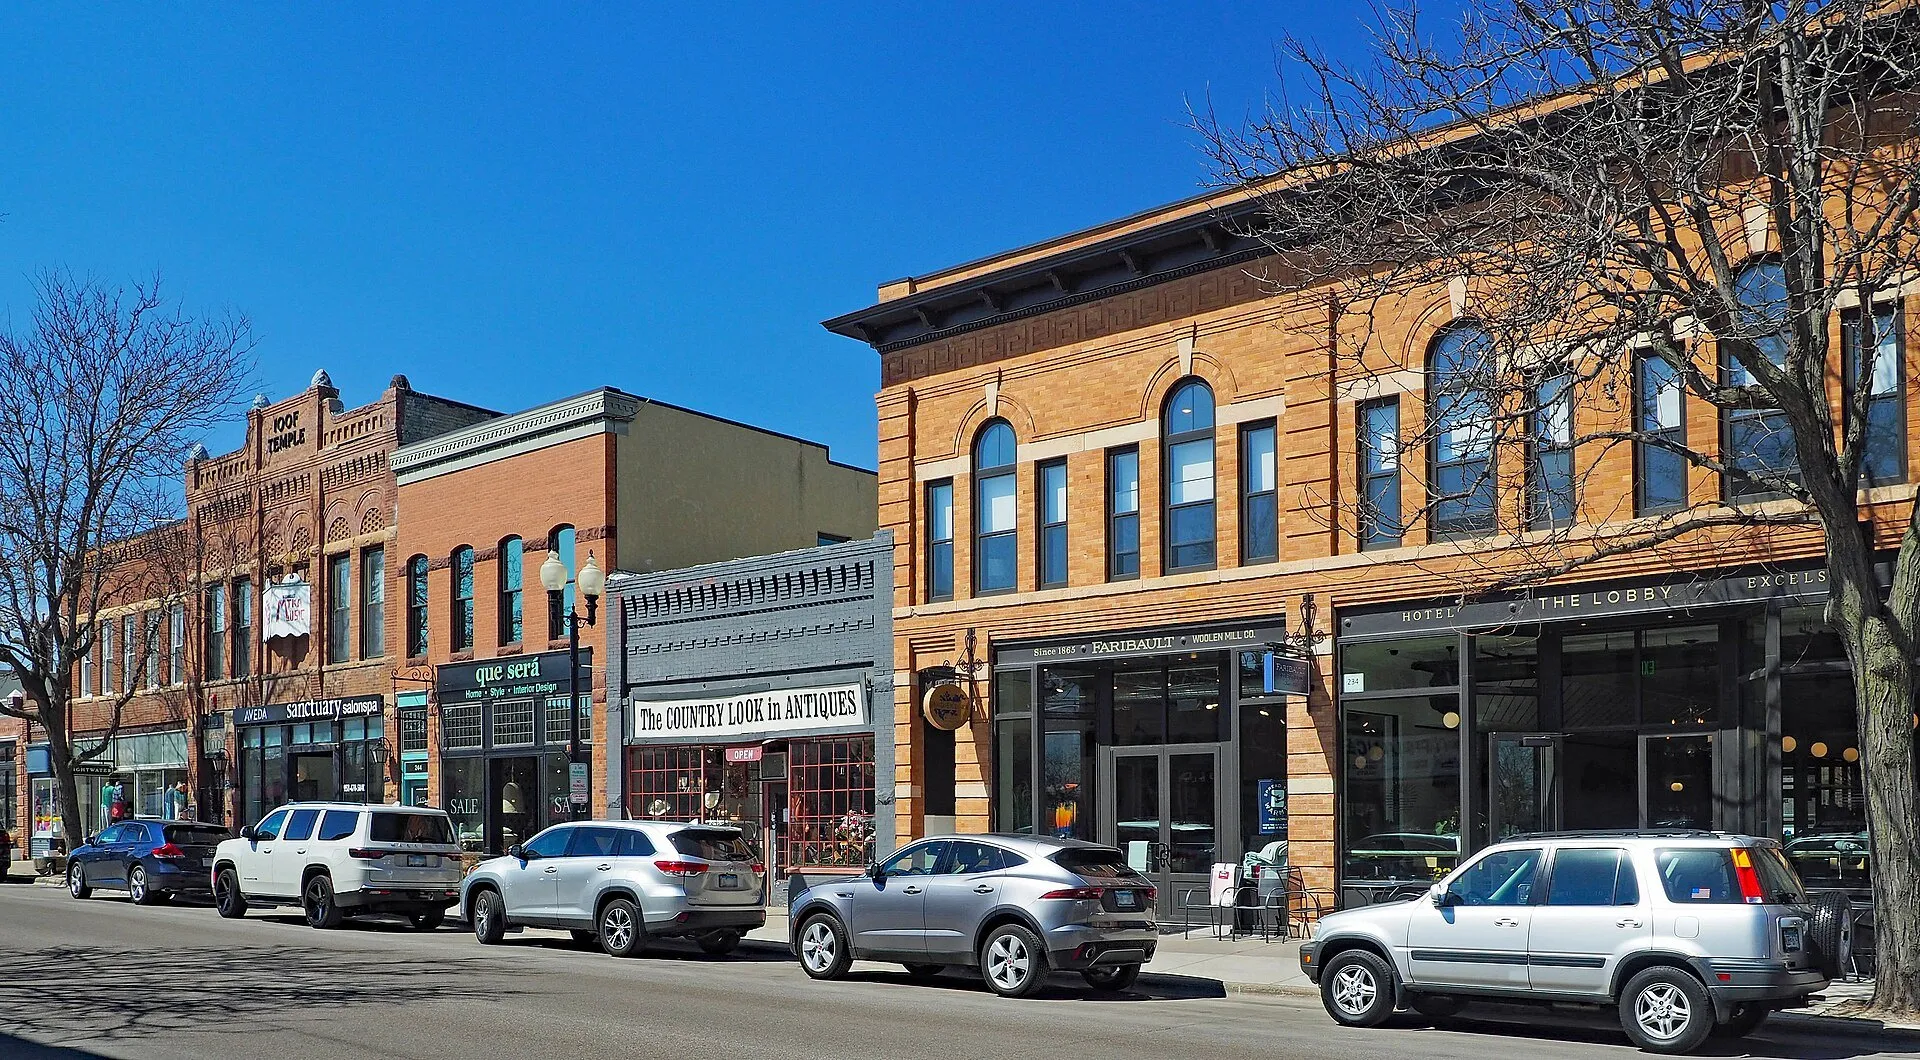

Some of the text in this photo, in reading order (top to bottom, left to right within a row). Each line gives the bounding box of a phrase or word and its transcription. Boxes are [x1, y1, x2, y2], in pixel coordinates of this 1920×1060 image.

[273, 411, 300, 433] IOOF
[267, 428, 305, 455] TEMPLE
[1402, 570, 1827, 622] HOTEL THE LOBBY EXCELS
[1033, 629, 1256, 657] Since 1865 FARIBAULT WOOLEN MILL CO.
[475, 656, 540, 688] que será
[1347, 678, 1359, 686] 234
[465, 682, 557, 699] Home Style Interior Design
[243, 699, 378, 721] AVEDA sanctuary salonspa
[640, 689, 857, 731] The COUNTRY LOOK in ANTIQUES
[734, 749, 753, 760] OPEN
[450, 798, 478, 814] SALE
[554, 797, 587, 813] SAE
